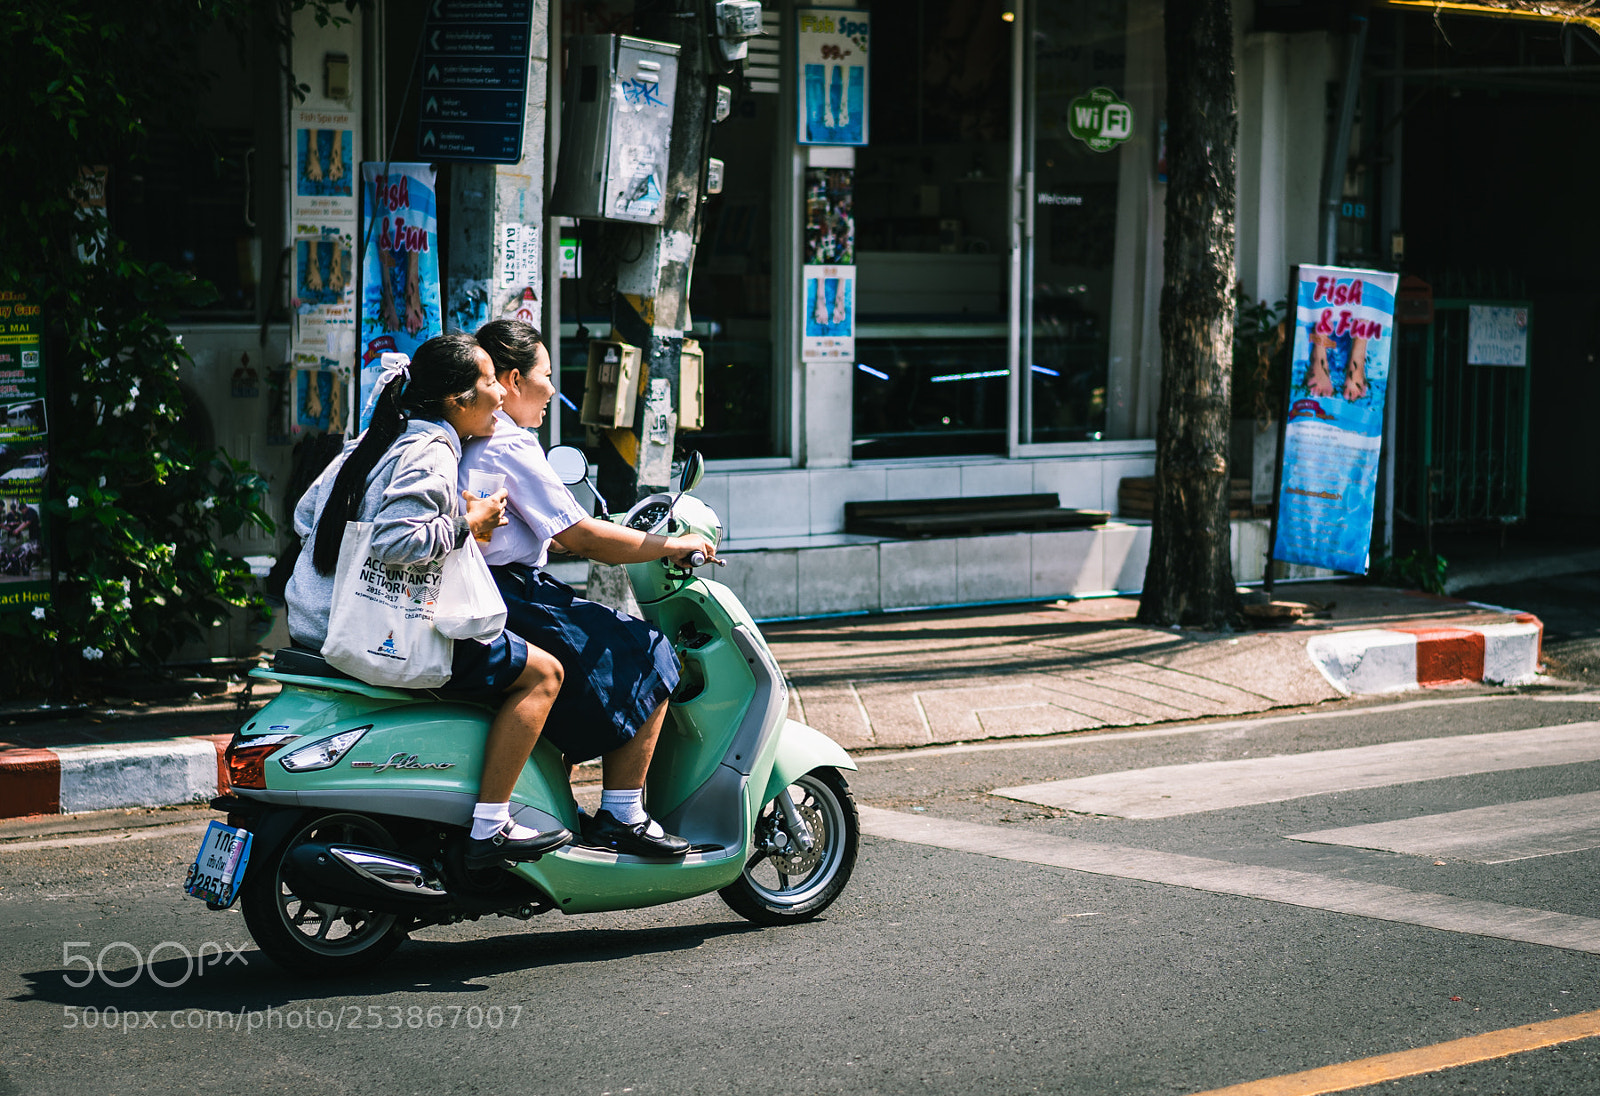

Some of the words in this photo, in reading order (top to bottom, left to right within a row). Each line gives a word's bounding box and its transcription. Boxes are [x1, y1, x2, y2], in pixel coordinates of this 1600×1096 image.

[800, 15, 835, 33] Fish
[838, 16, 868, 38] Spa
[1036, 192, 1083, 207] Welcome
[394, 216, 429, 253] Fun
[1313, 274, 1363, 307] Fish
[14, 303, 41, 317] Care
[10, 323, 29, 333] MAI
[1316, 308, 1334, 335] &
[1335, 310, 1383, 341] Fun
[22, 591, 51, 603] Here
